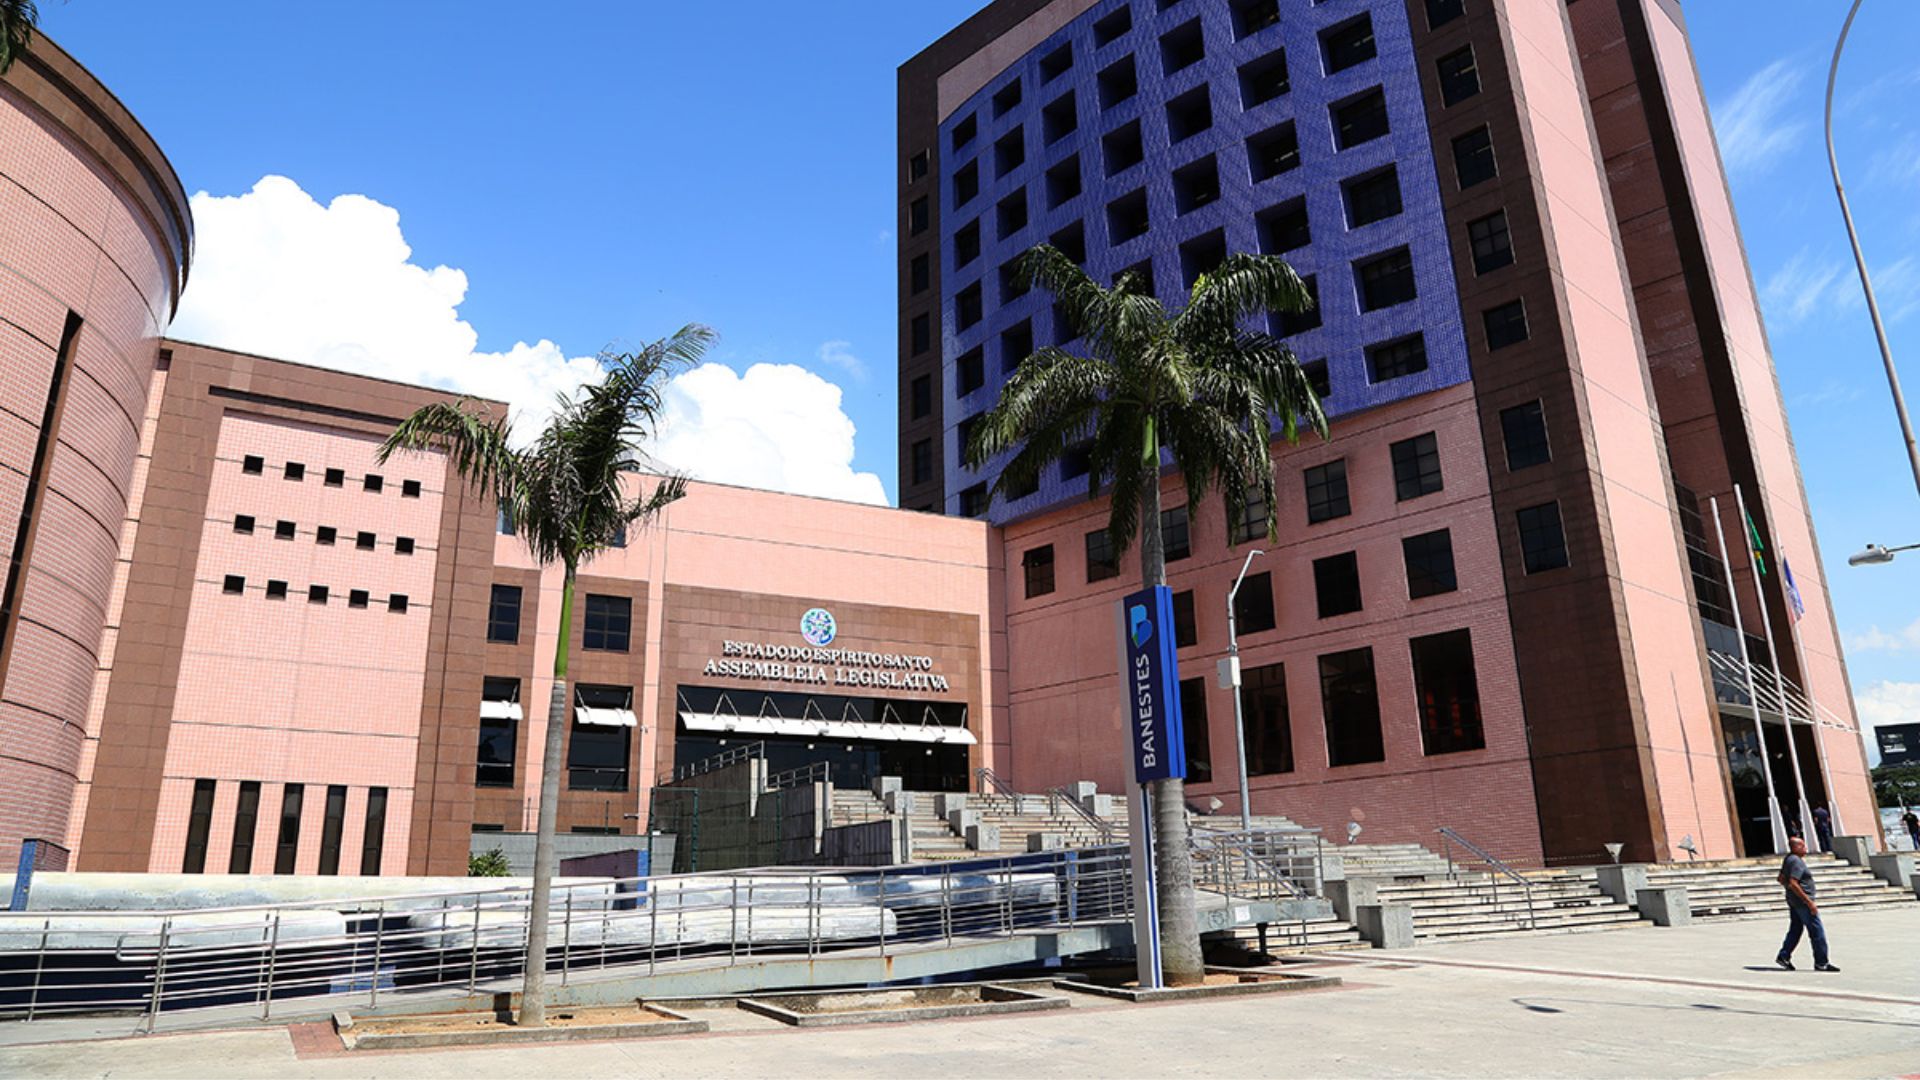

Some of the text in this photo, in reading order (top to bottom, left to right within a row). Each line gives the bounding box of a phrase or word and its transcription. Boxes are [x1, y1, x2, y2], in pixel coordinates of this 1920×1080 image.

[703, 658, 949, 691] ASSEMBLEIA LEGISLATIVA
[1136, 653, 1156, 768] BANESTES
